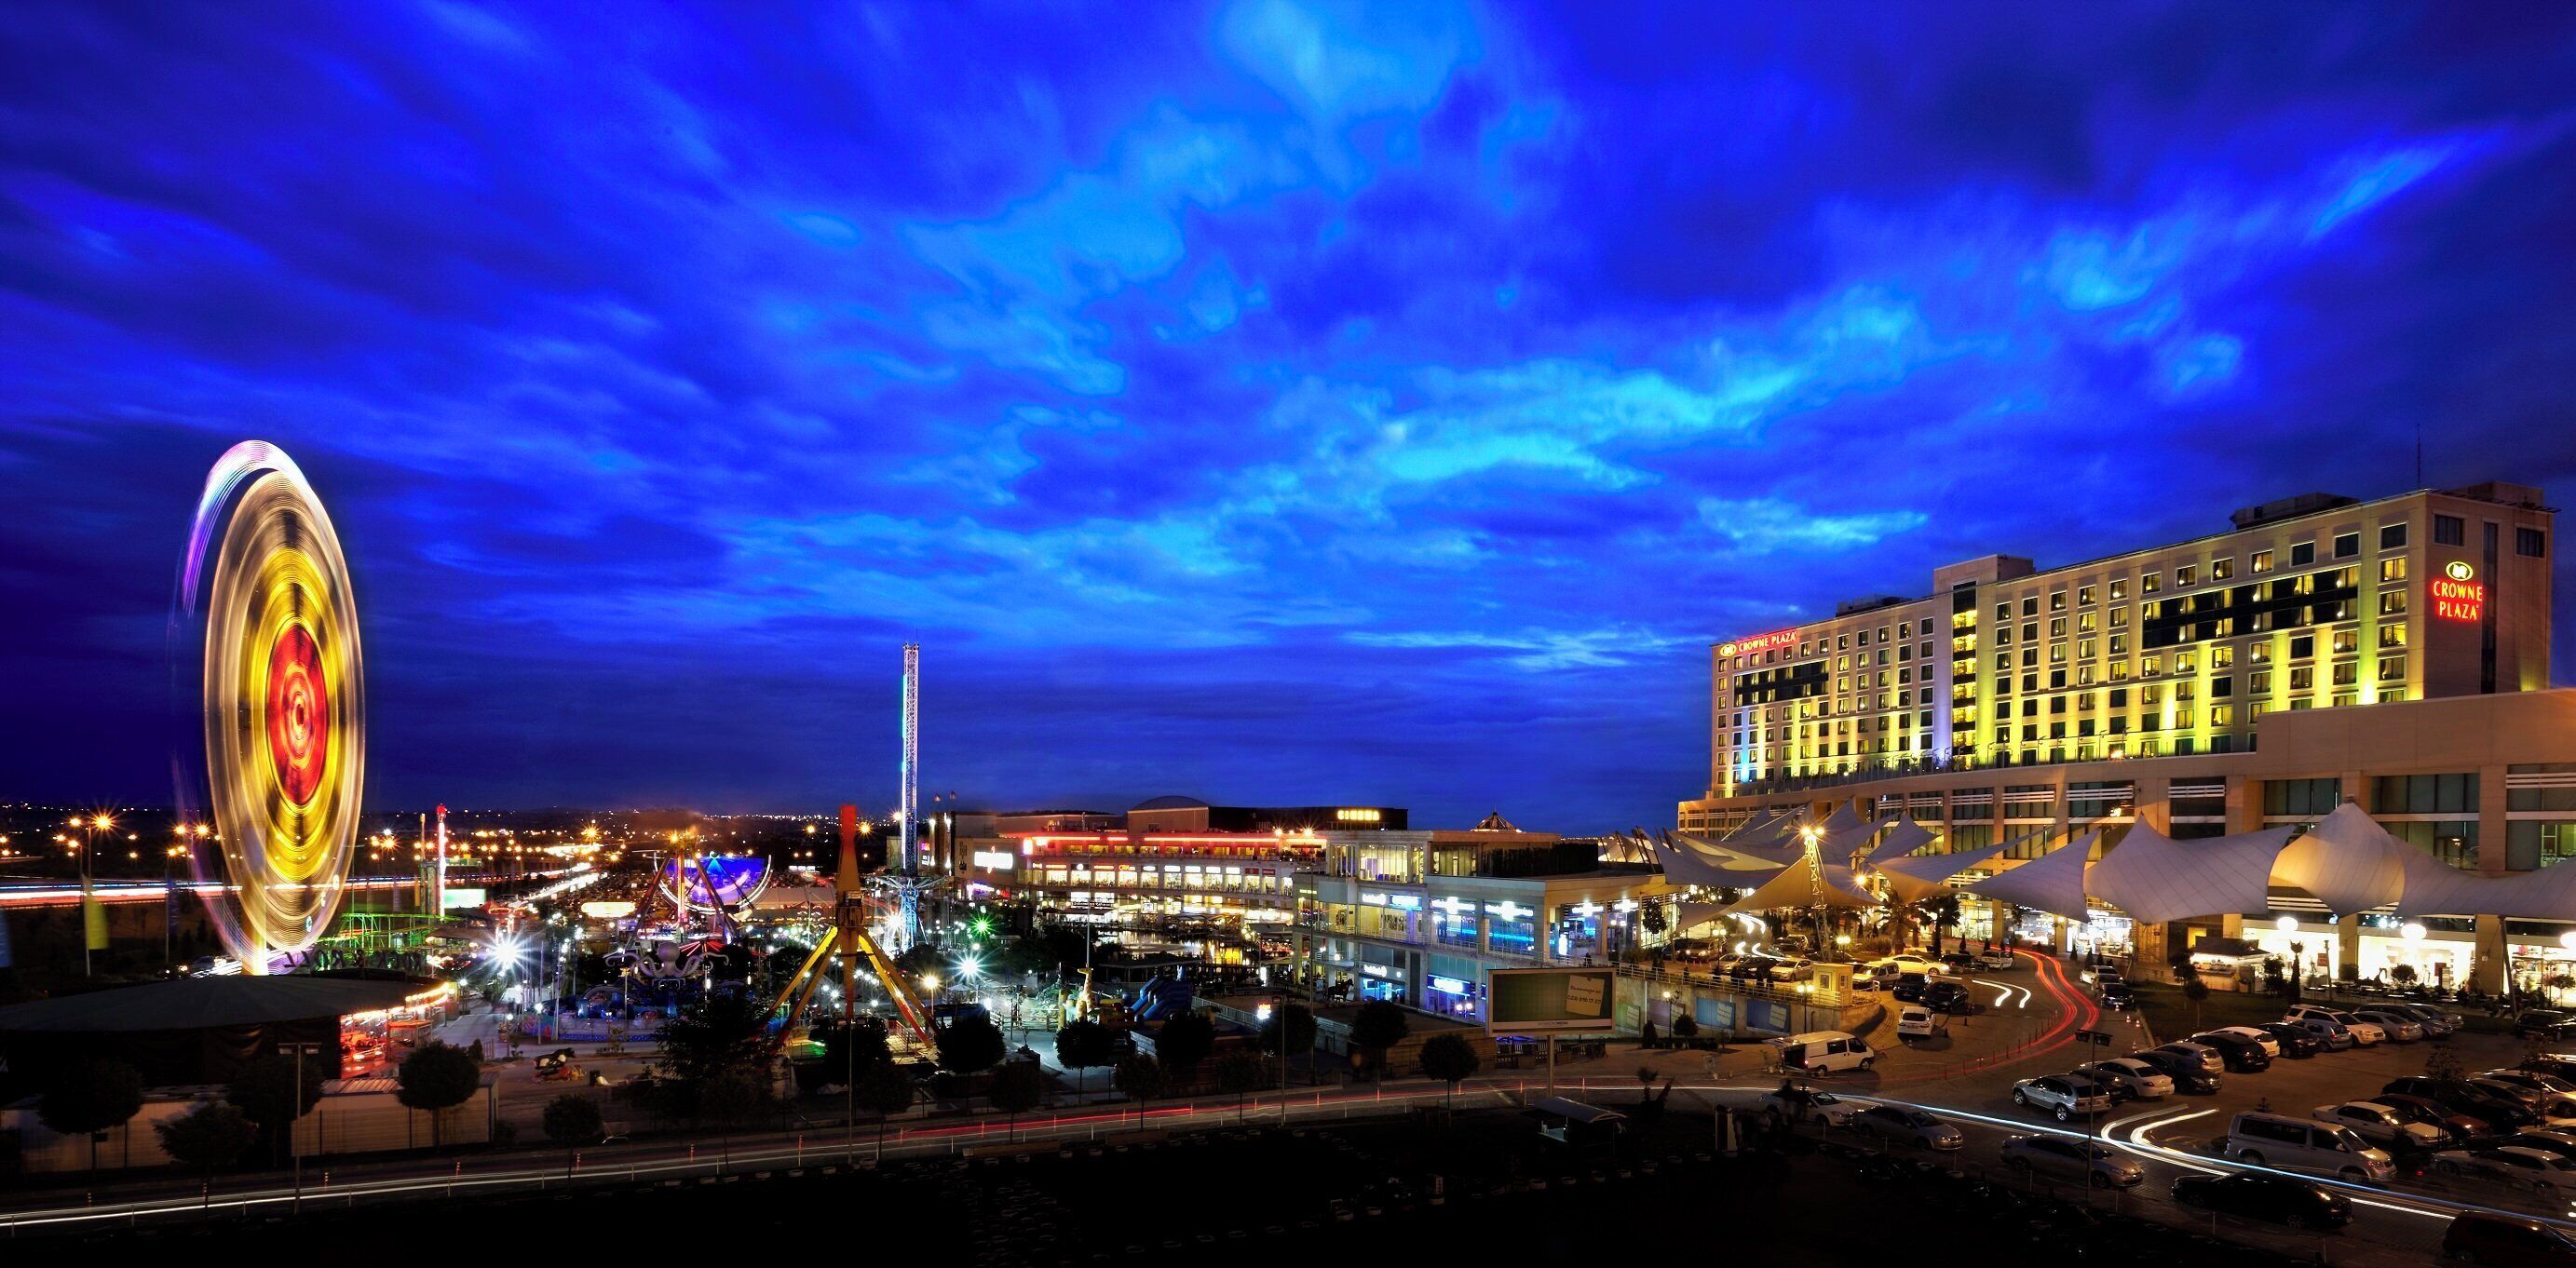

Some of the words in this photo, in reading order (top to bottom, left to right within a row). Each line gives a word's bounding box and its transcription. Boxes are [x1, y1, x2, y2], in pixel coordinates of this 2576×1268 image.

[2433, 580, 2483, 602] CROWNE
[2439, 601, 2478, 621] PLAZA
[1738, 638, 1769, 653] CROWNE
[1771, 632, 1797, 646] PLAZA
